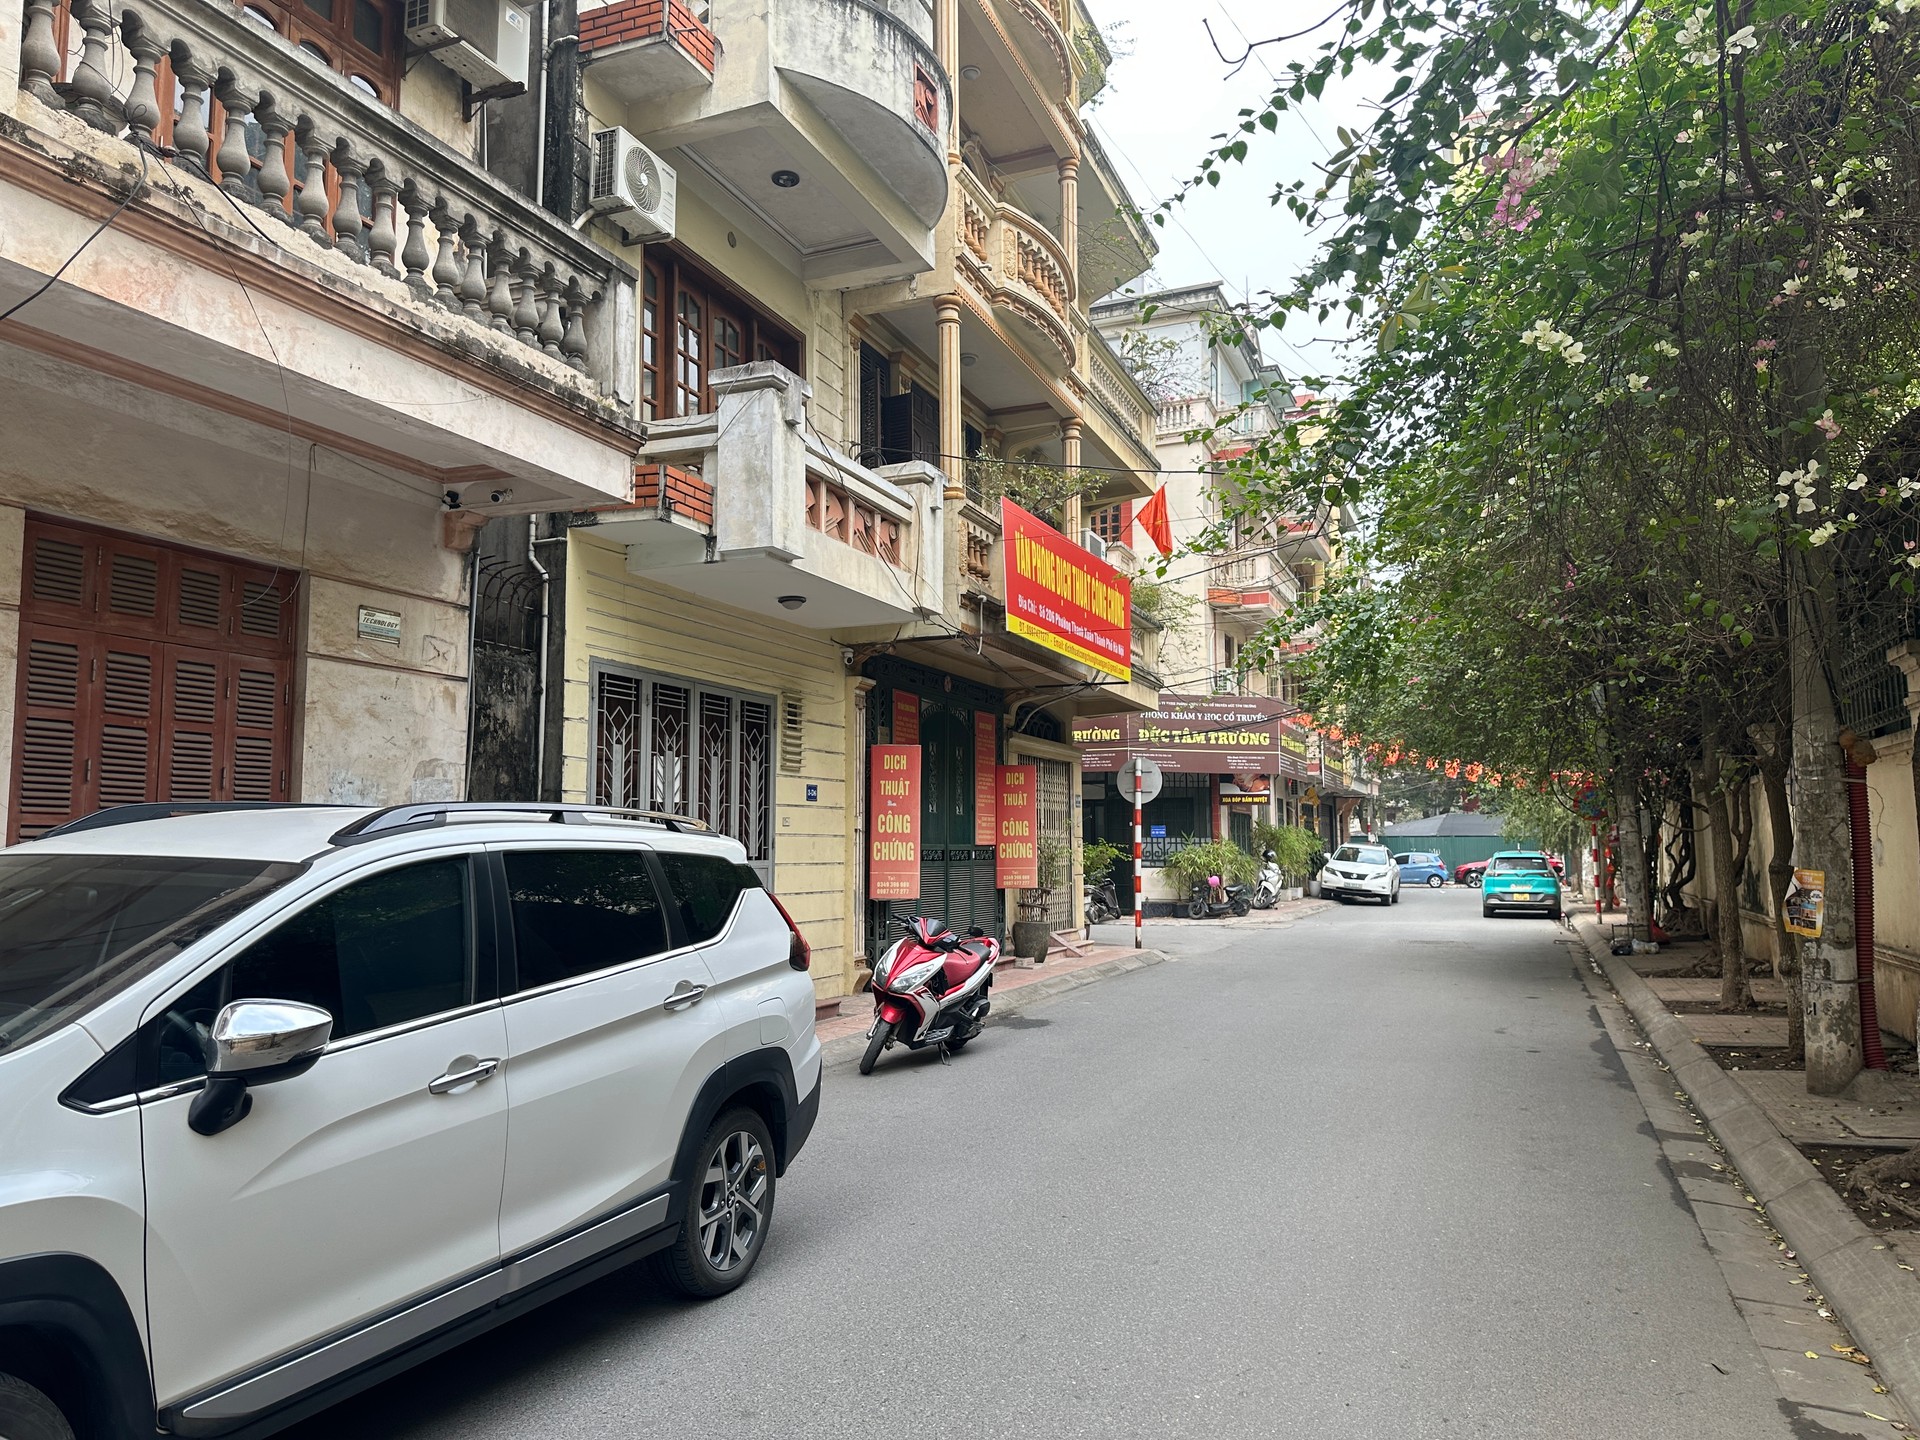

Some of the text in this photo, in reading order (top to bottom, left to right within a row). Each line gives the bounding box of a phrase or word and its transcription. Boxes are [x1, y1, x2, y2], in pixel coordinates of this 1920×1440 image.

[1015, 525, 1125, 629] VĂN PHÒNG DỊCH THUẬT CÔNG CHỨNG
[1039, 604, 1046, 619] Số
[362, 617, 399, 628] TECHNOLOGY
[1170, 710, 1196, 720] KHÁM
[1196, 712, 1203, 720] Y
[1072, 725, 1121, 743] RƯỜNG
[1138, 725, 1170, 744] ĐỨC
[1171, 727, 1207, 744] TÂM
[1207, 728, 1270, 745] TRƯỜNG
[884, 754, 907, 773] DỊCH
[880, 777, 910, 799] THUẬT
[1006, 772, 1025, 788] DỊCH
[1003, 791, 1028, 809] THUẬT
[877, 810, 911, 834] CÔNG
[1002, 817, 1029, 837] CÔNG
[873, 837, 915, 861] CHỨNG
[999, 840, 1033, 859] CHỨNG
